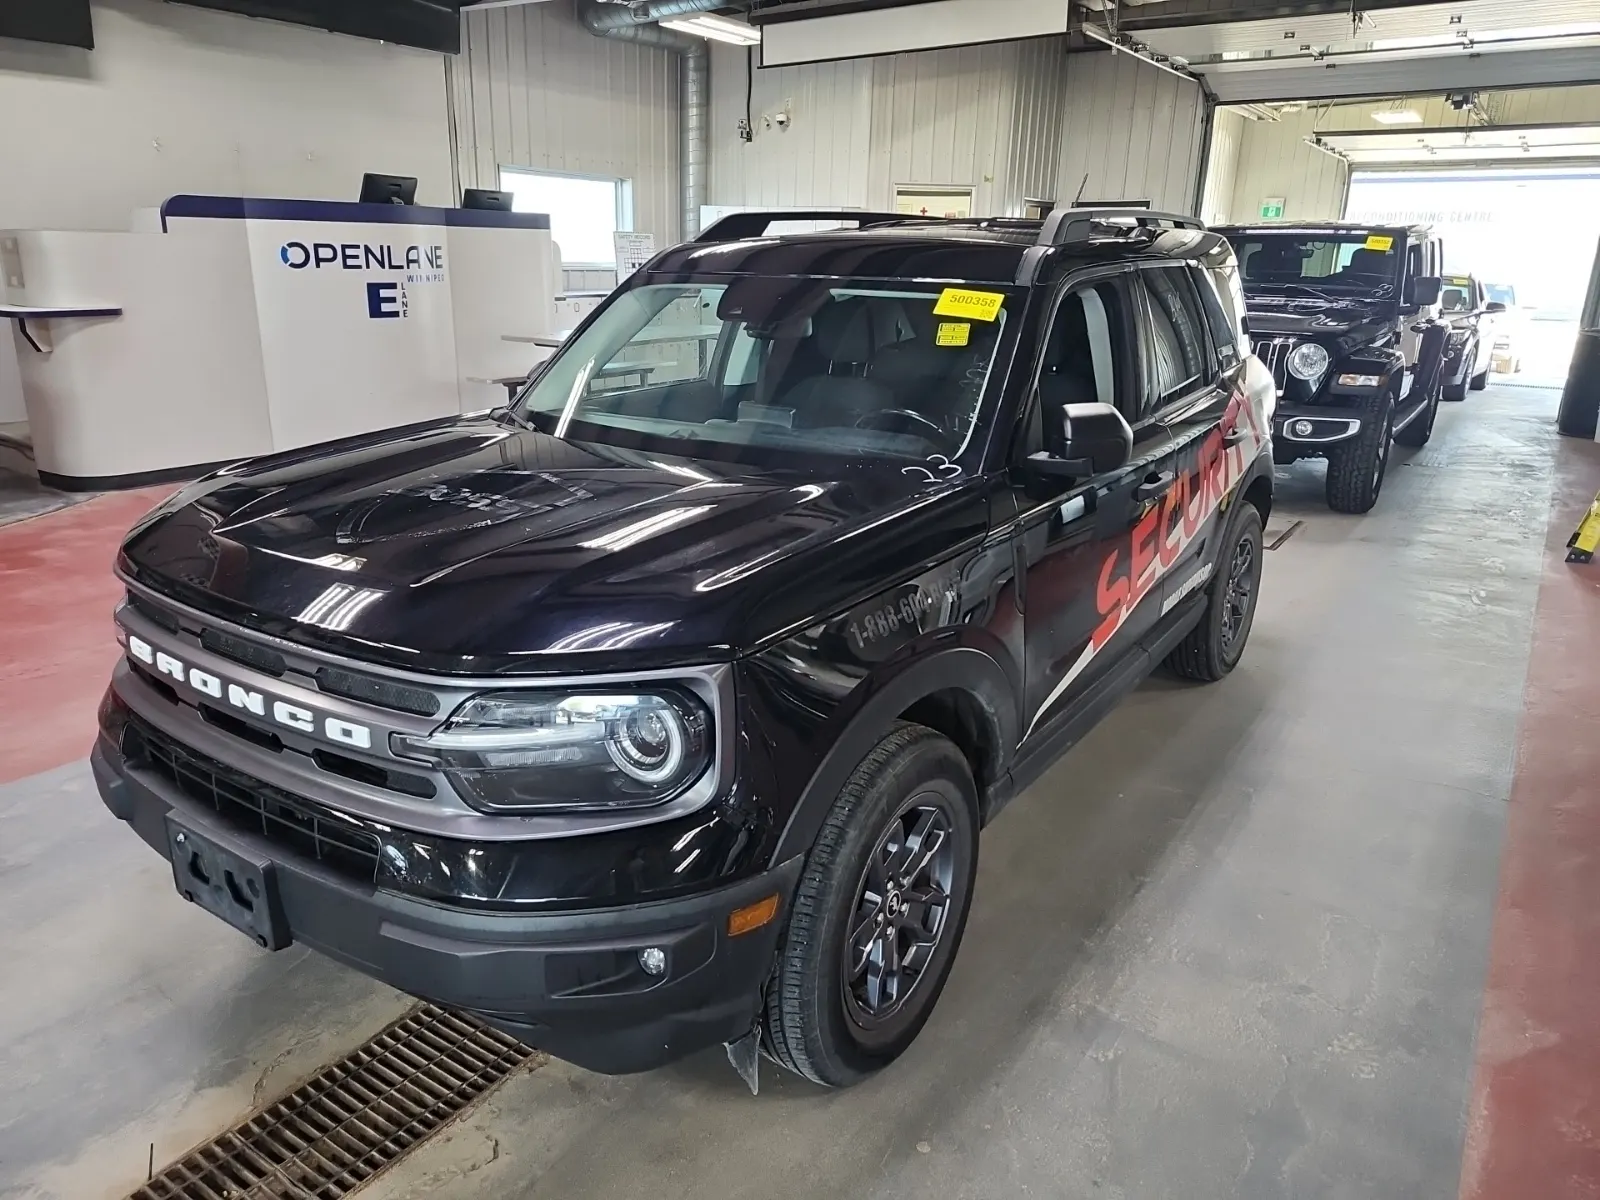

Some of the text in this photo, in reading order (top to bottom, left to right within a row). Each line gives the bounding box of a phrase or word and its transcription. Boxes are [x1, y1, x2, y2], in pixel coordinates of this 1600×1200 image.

[1449, 211, 1494, 222] CENTRE
[280, 241, 444, 269] OPENLANE
[366, 282, 409, 318] E LANE
[949, 294, 997, 308] 500358
[1091, 388, 1261, 654] SECURITY
[129, 635, 372, 749] BRONCO
